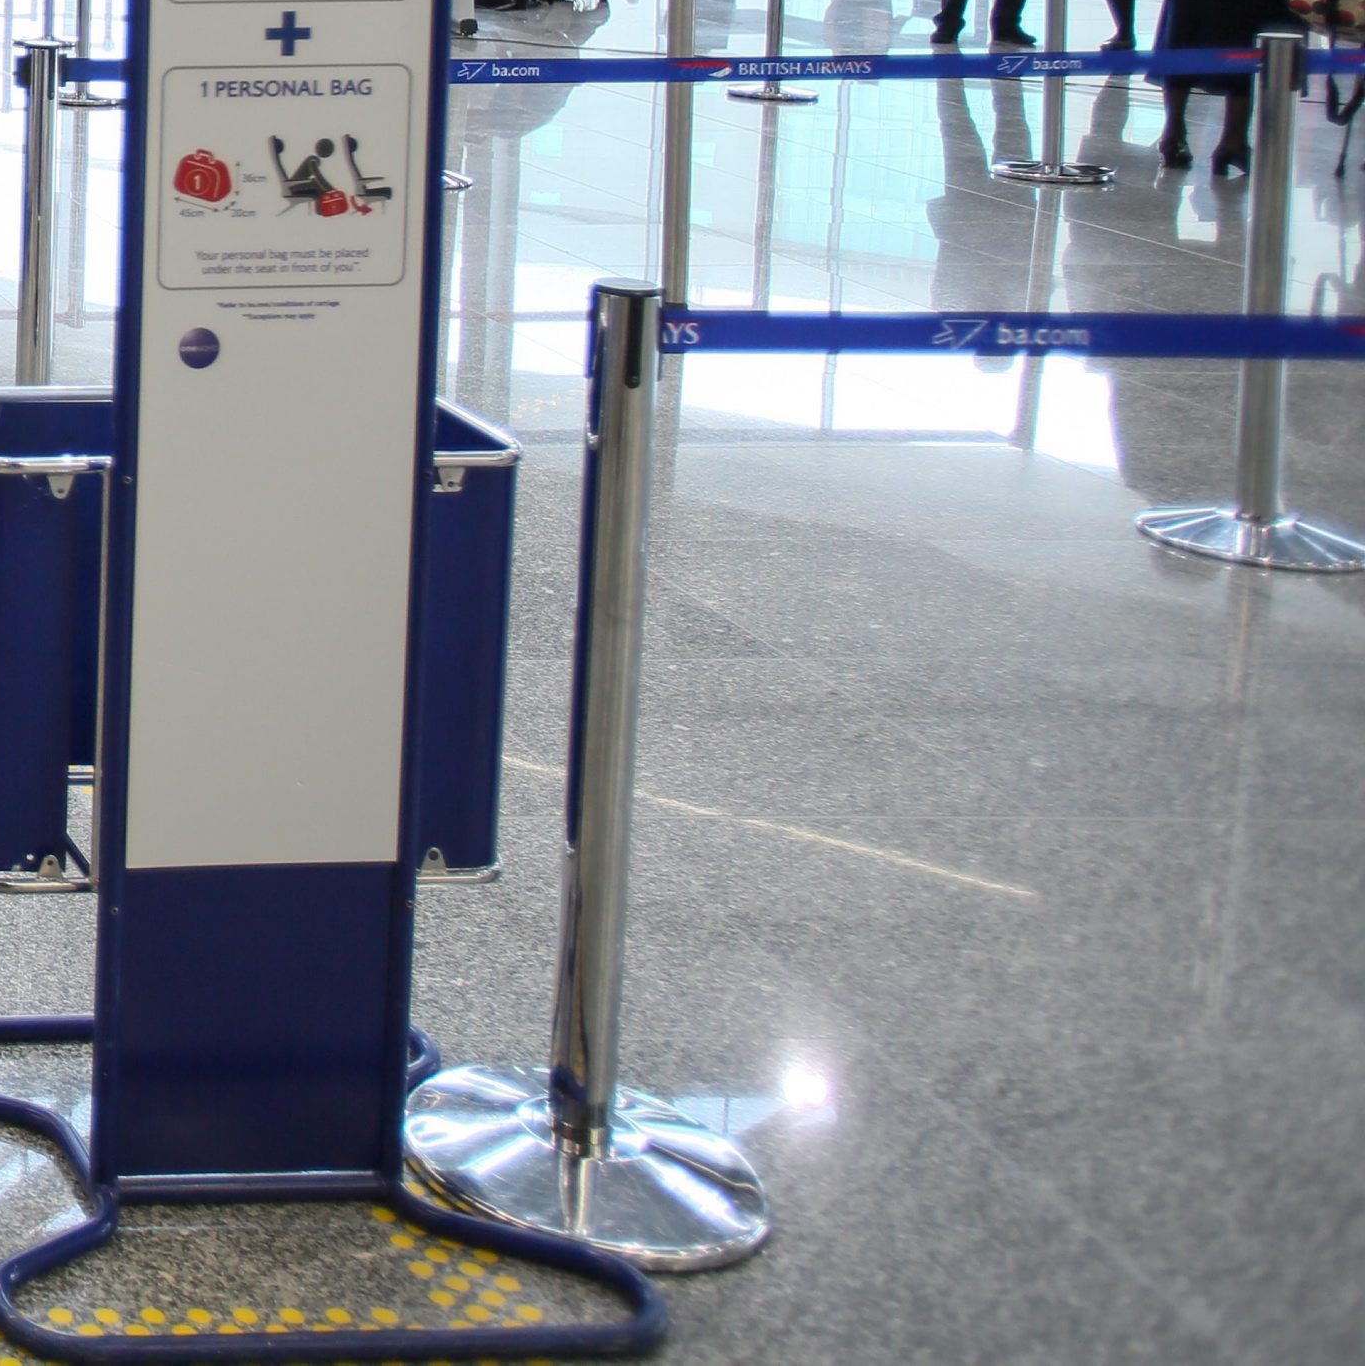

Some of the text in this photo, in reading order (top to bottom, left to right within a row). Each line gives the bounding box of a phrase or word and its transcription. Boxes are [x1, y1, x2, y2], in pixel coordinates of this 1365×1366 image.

[491, 63, 540, 78] ba.com
[738, 60, 871, 76] BRITISH AIRWAYS
[1032, 57, 1082, 71] ba.com
[201, 79, 373, 98] 1 PERSONAL BAG
[195, 248, 370, 262] Your personal bag must be placed
[202, 262, 332, 274] under the seat in front of
[997, 322, 1090, 345] ba.com
